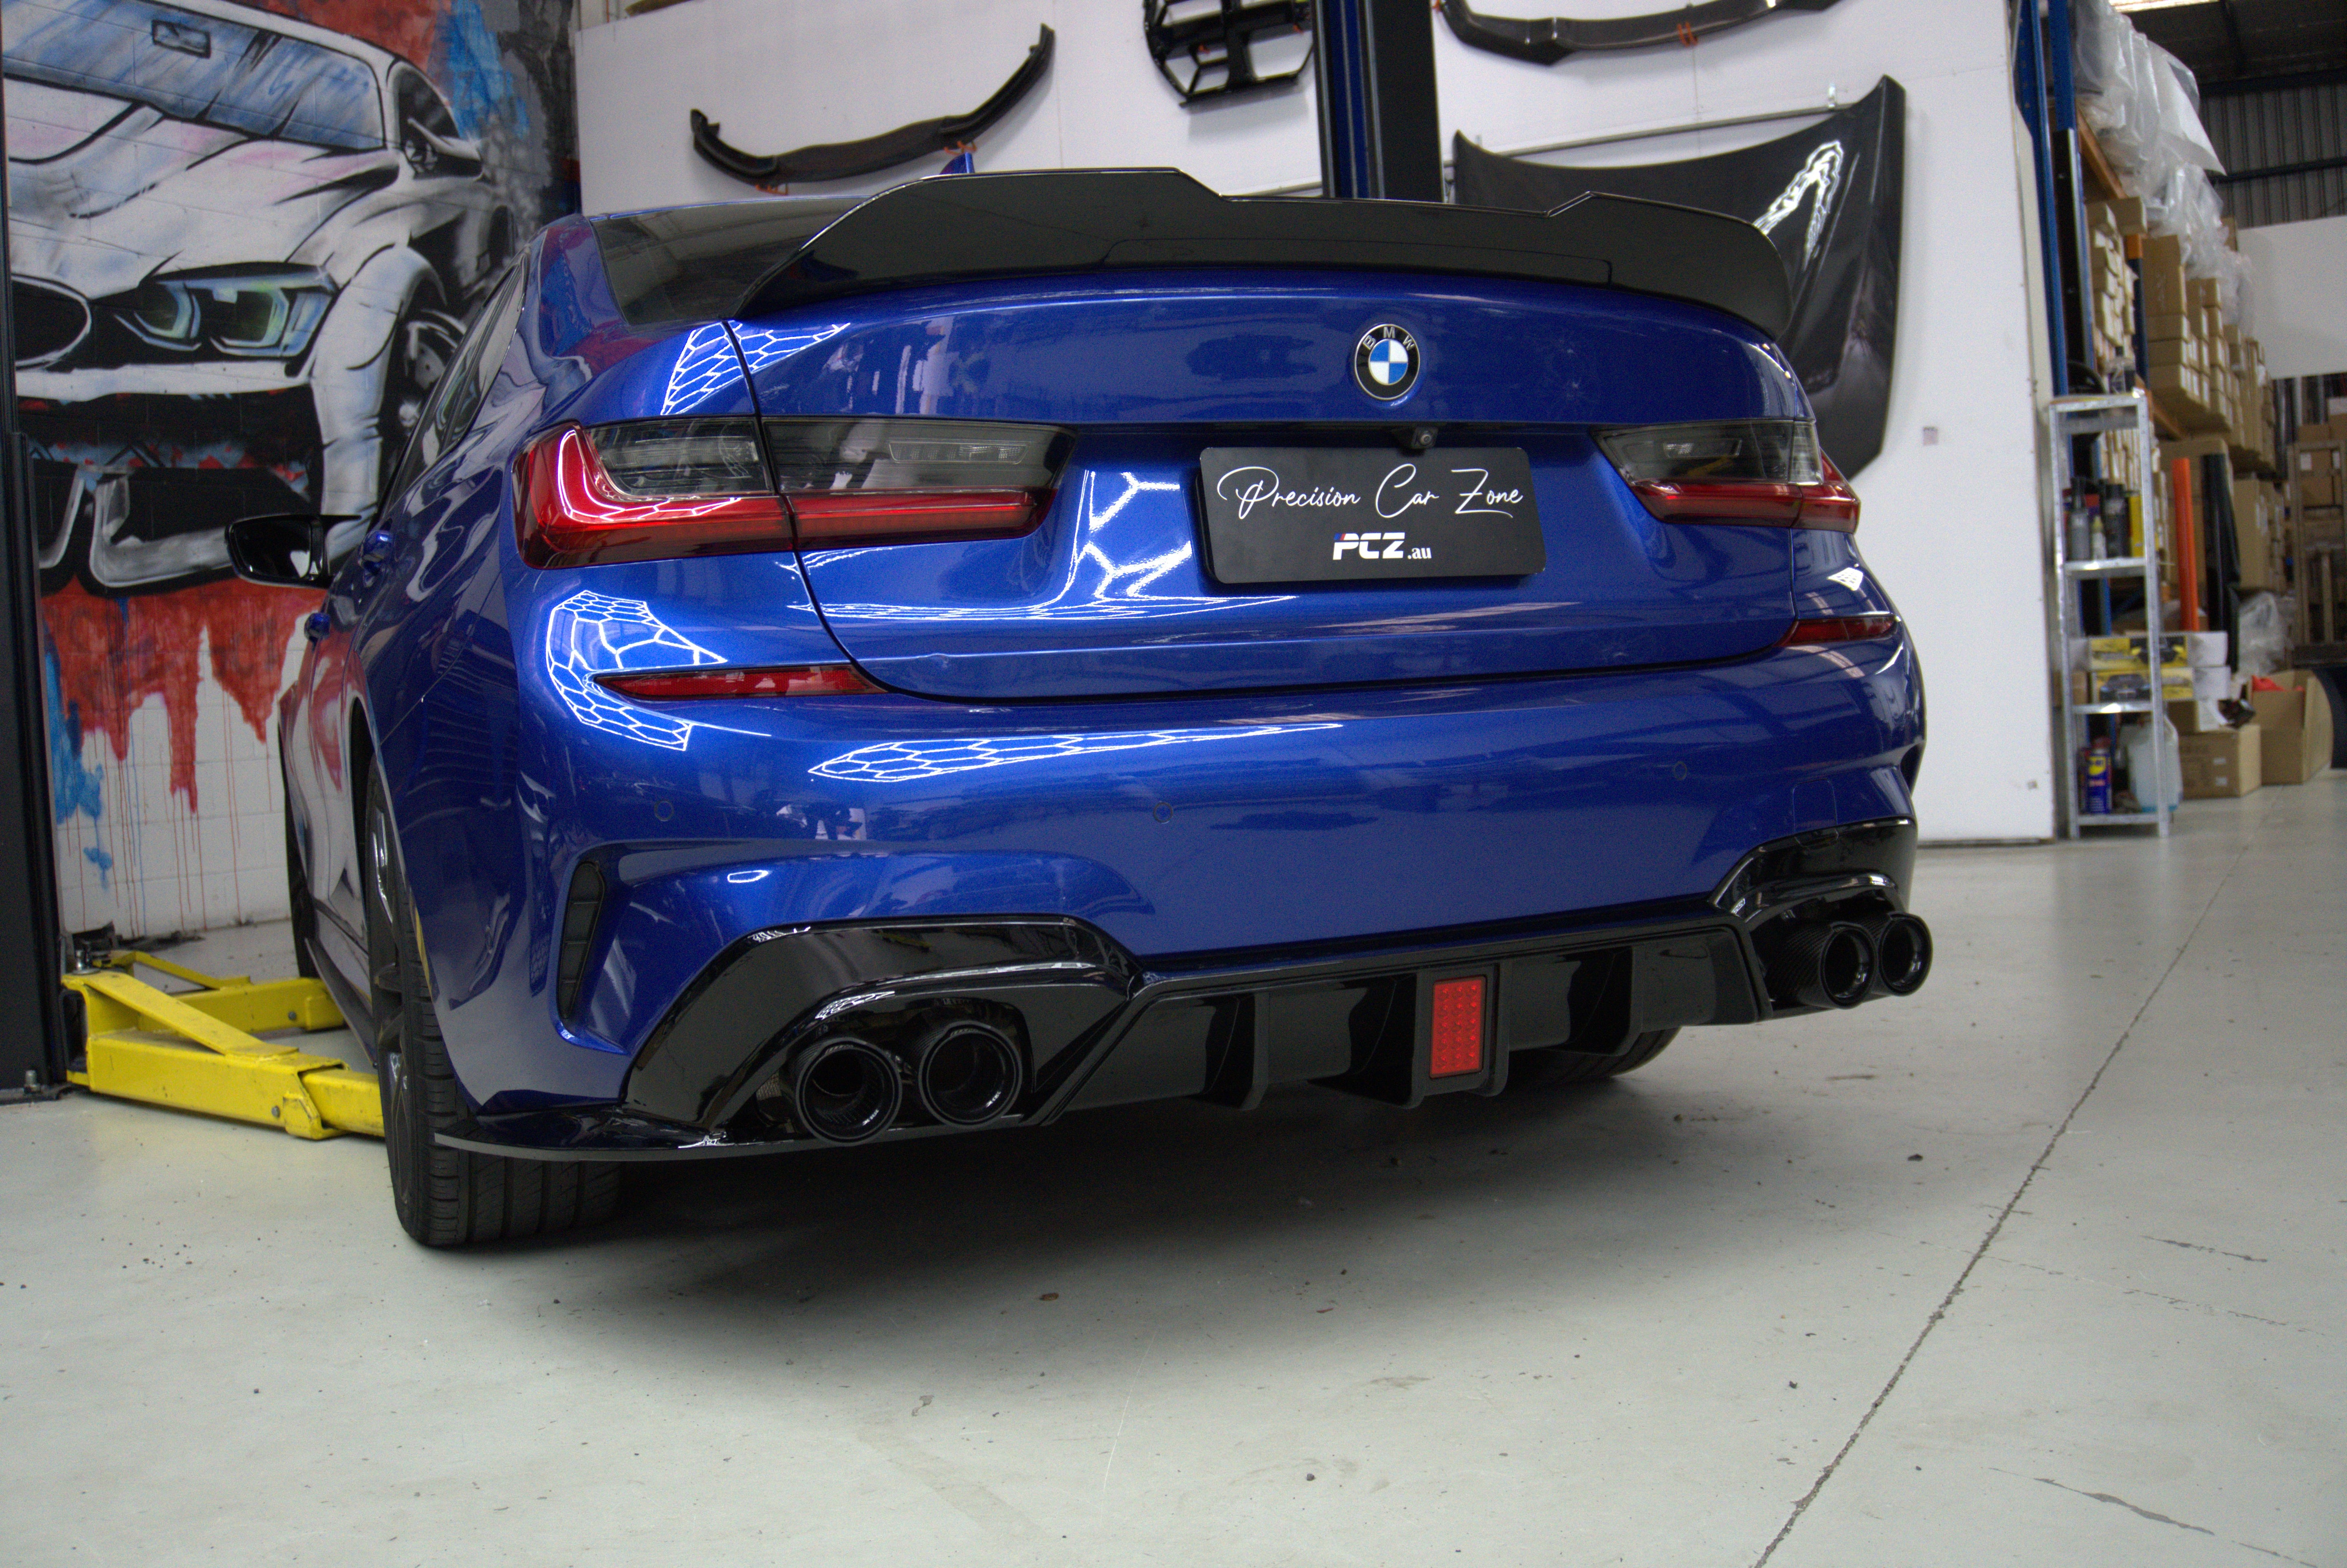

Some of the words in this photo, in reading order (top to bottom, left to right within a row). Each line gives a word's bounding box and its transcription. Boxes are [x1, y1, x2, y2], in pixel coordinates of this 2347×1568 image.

[1362, 326, 1415, 351] BMW
[1216, 465, 1361, 520] Precision
[1375, 463, 1440, 518] Car
[1451, 468, 1524, 518] Zone
